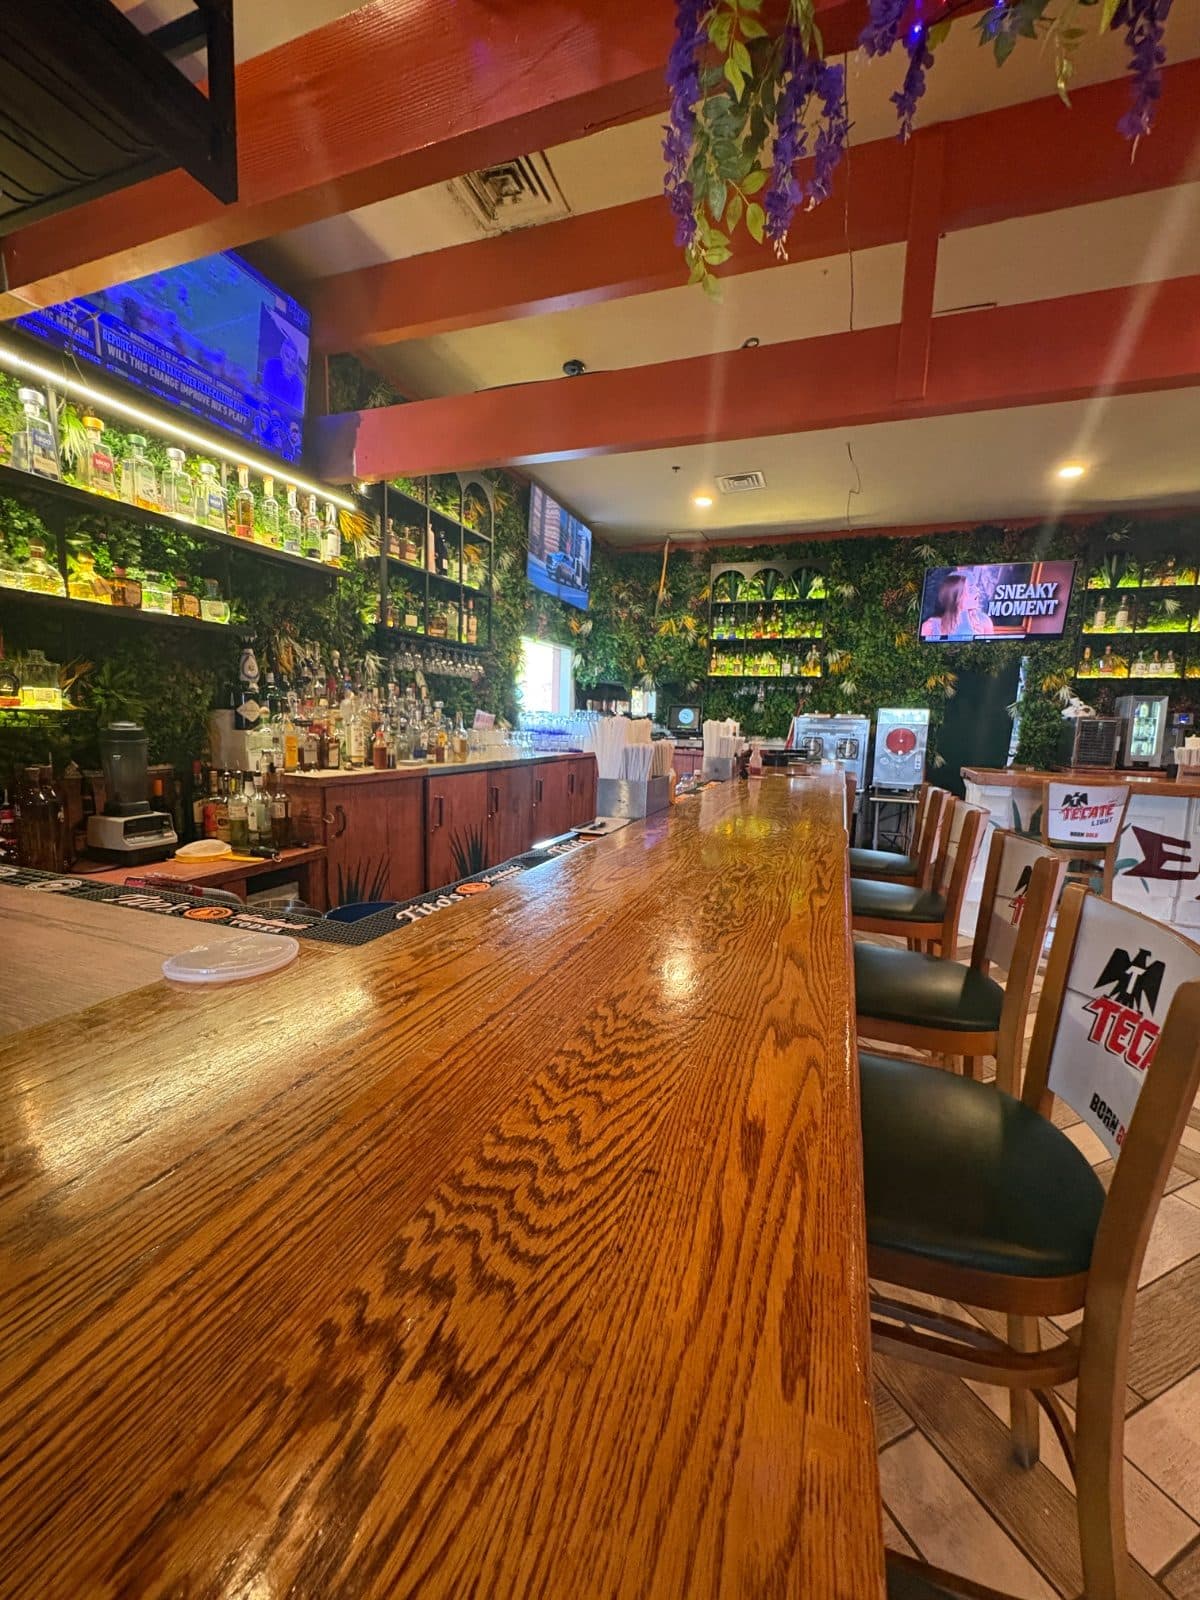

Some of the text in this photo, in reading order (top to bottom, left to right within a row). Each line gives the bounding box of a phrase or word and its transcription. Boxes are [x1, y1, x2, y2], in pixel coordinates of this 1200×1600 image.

[102, 328, 131, 352] REPORT:
[107, 343, 128, 364] WILL
[130, 354, 148, 374] THIS
[150, 365, 180, 391] CHANGE
[994, 582, 1058, 600] SNEAKY
[988, 599, 1059, 617] MOMENT
[1061, 803, 1115, 821] TECATE
[1091, 816, 1113, 827] LIGHT
[395, 893, 464, 922] Tito's
[1089, 1092, 1120, 1137] BORN
